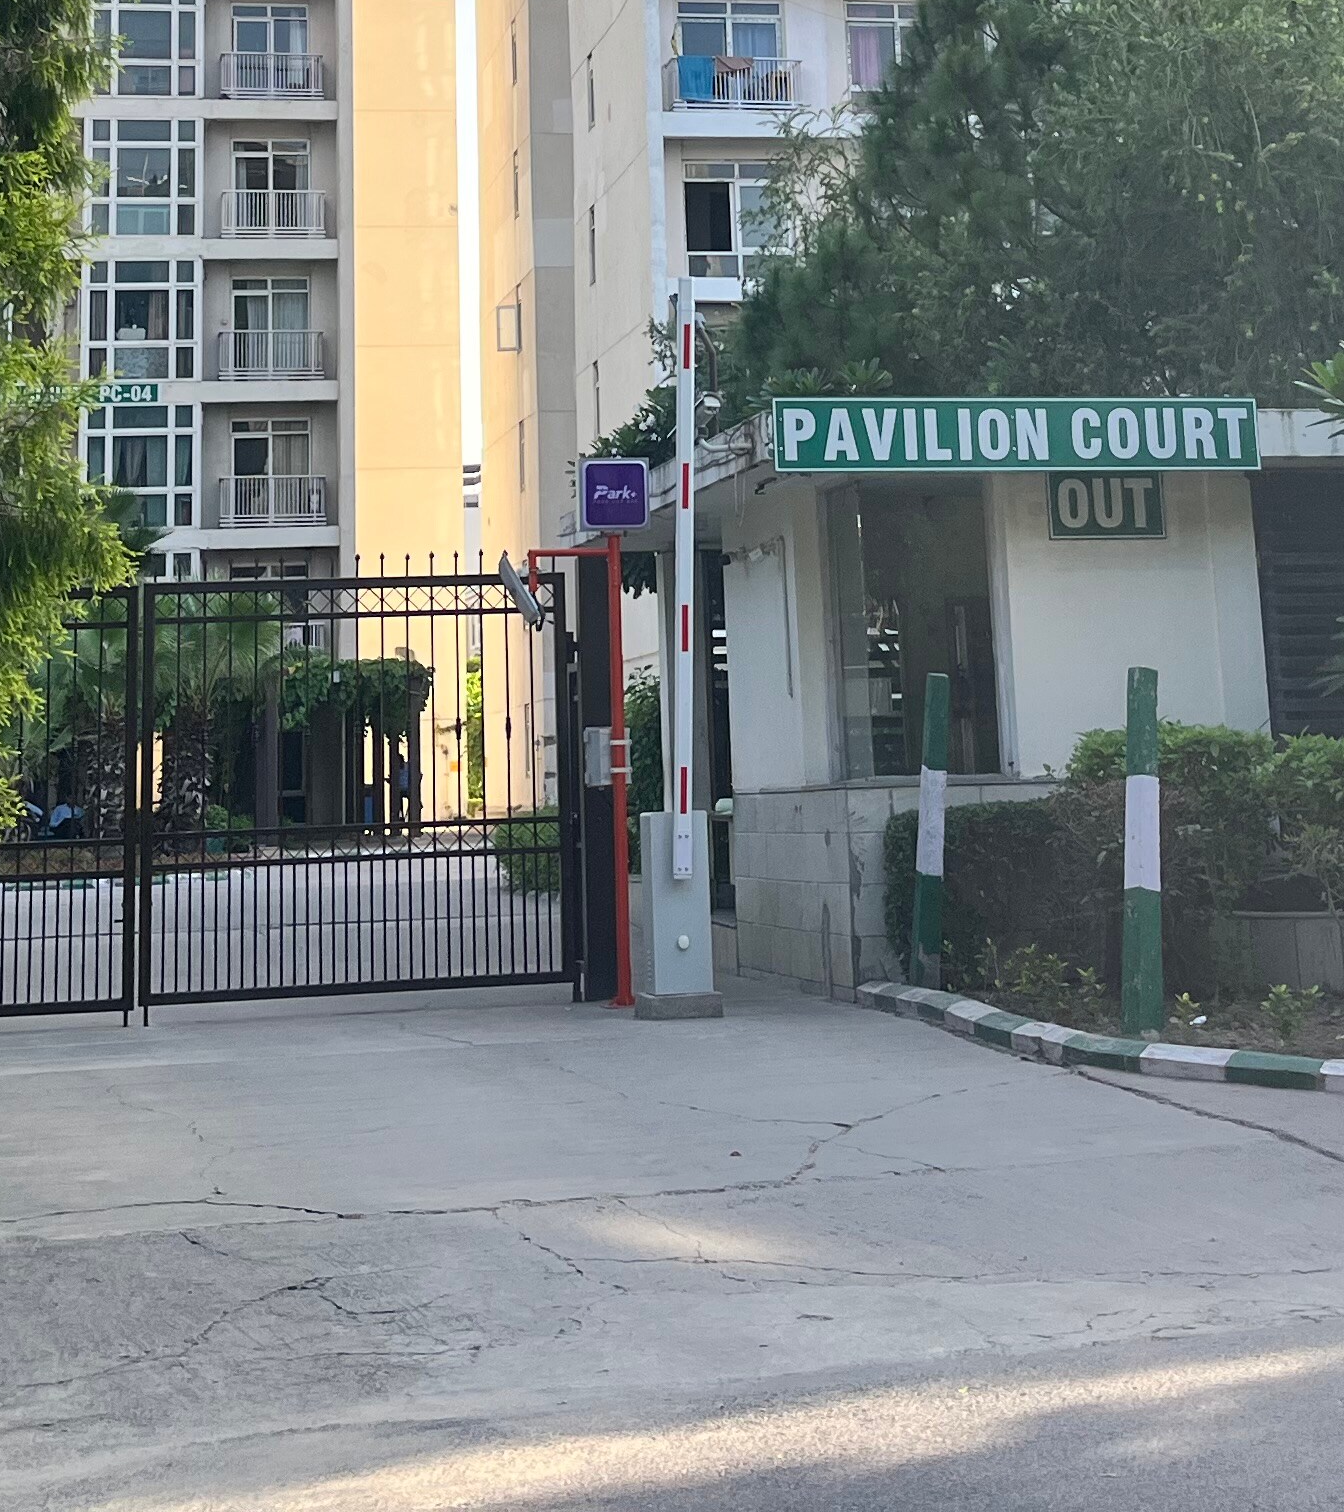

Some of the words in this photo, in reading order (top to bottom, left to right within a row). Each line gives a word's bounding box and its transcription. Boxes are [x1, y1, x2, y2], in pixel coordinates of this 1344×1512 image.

[99, 385, 152, 402] PC-04
[784, 408, 1050, 461] PAVILION
[1072, 407, 1248, 459] COURT
[1058, 477, 1152, 528] OUT
